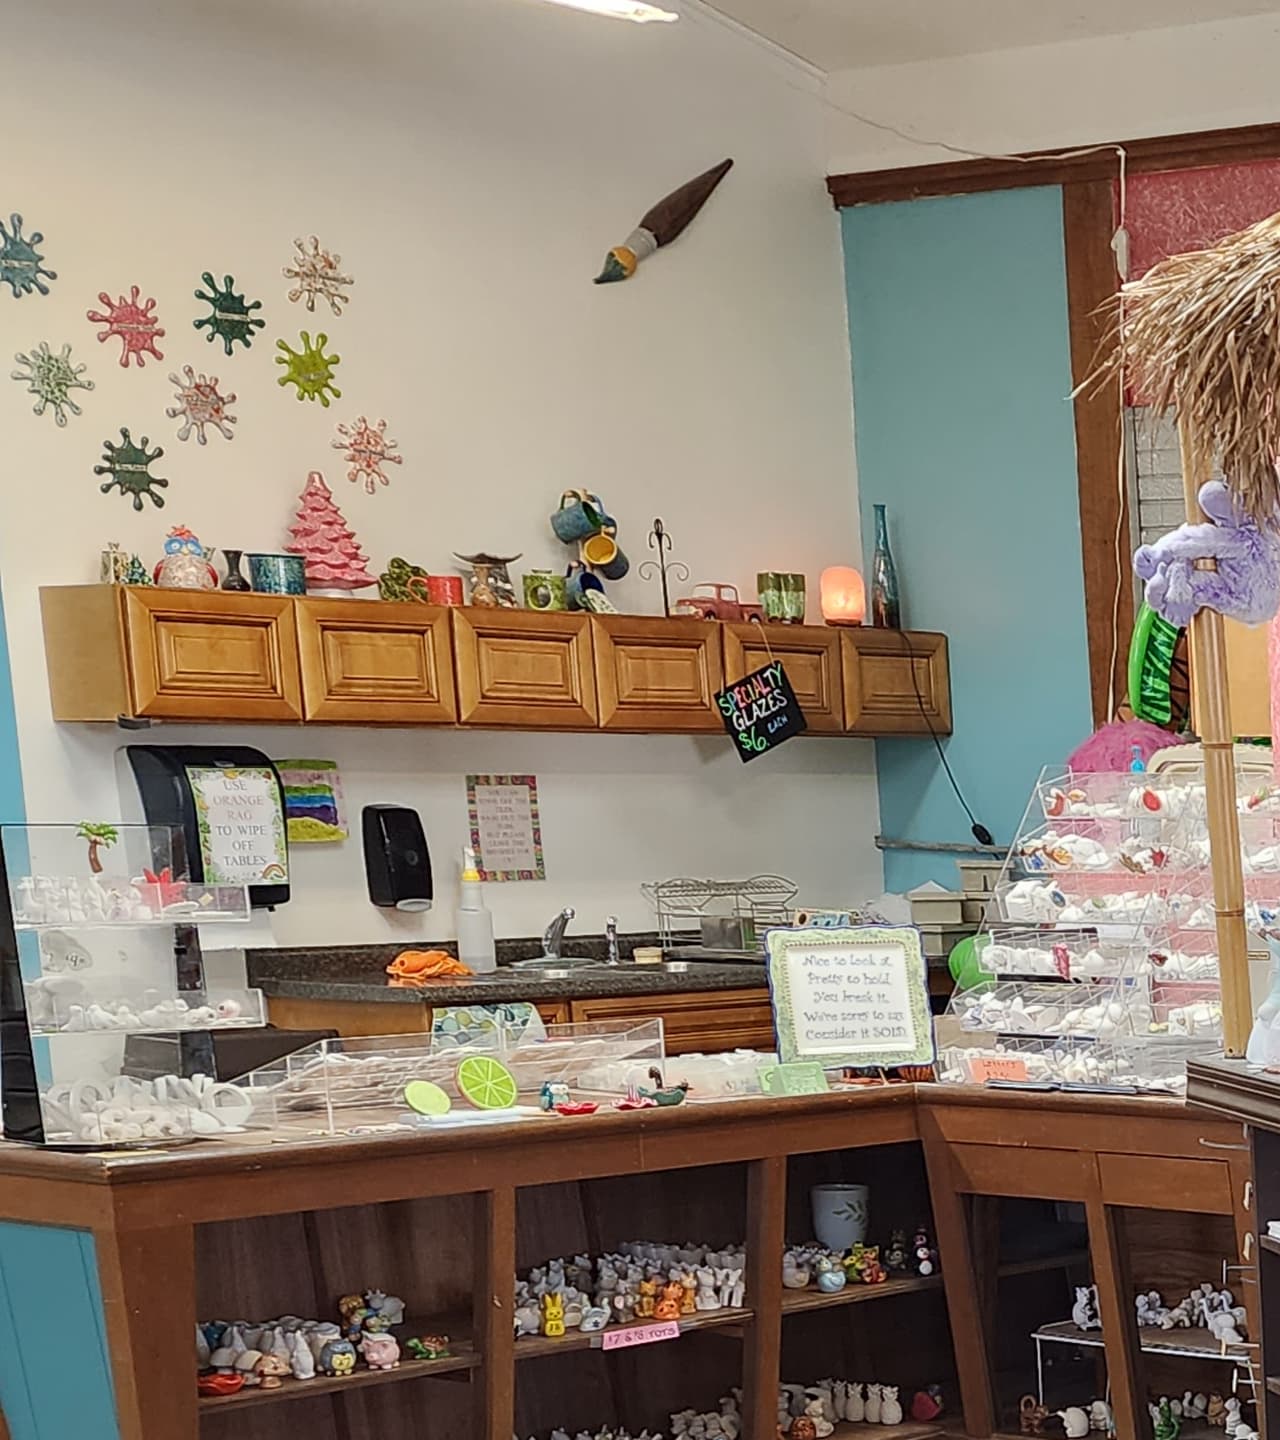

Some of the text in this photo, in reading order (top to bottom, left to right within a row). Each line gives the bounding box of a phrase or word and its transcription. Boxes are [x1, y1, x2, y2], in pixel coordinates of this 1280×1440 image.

[719, 664, 782, 717] SPECIALTY
[732, 688, 788, 732] GLAZES
[222, 780, 248, 791] USE
[213, 795, 265, 806] ORANGE
[216, 825, 268, 836] TO WIPE
[231, 840, 254, 851] OFF
[223, 856, 267, 867] TABLES
[802, 955, 830, 967] Nice
[834, 956, 847, 966] to
[847, 975, 861, 984] to
[806, 1026, 857, 1040] Consider
